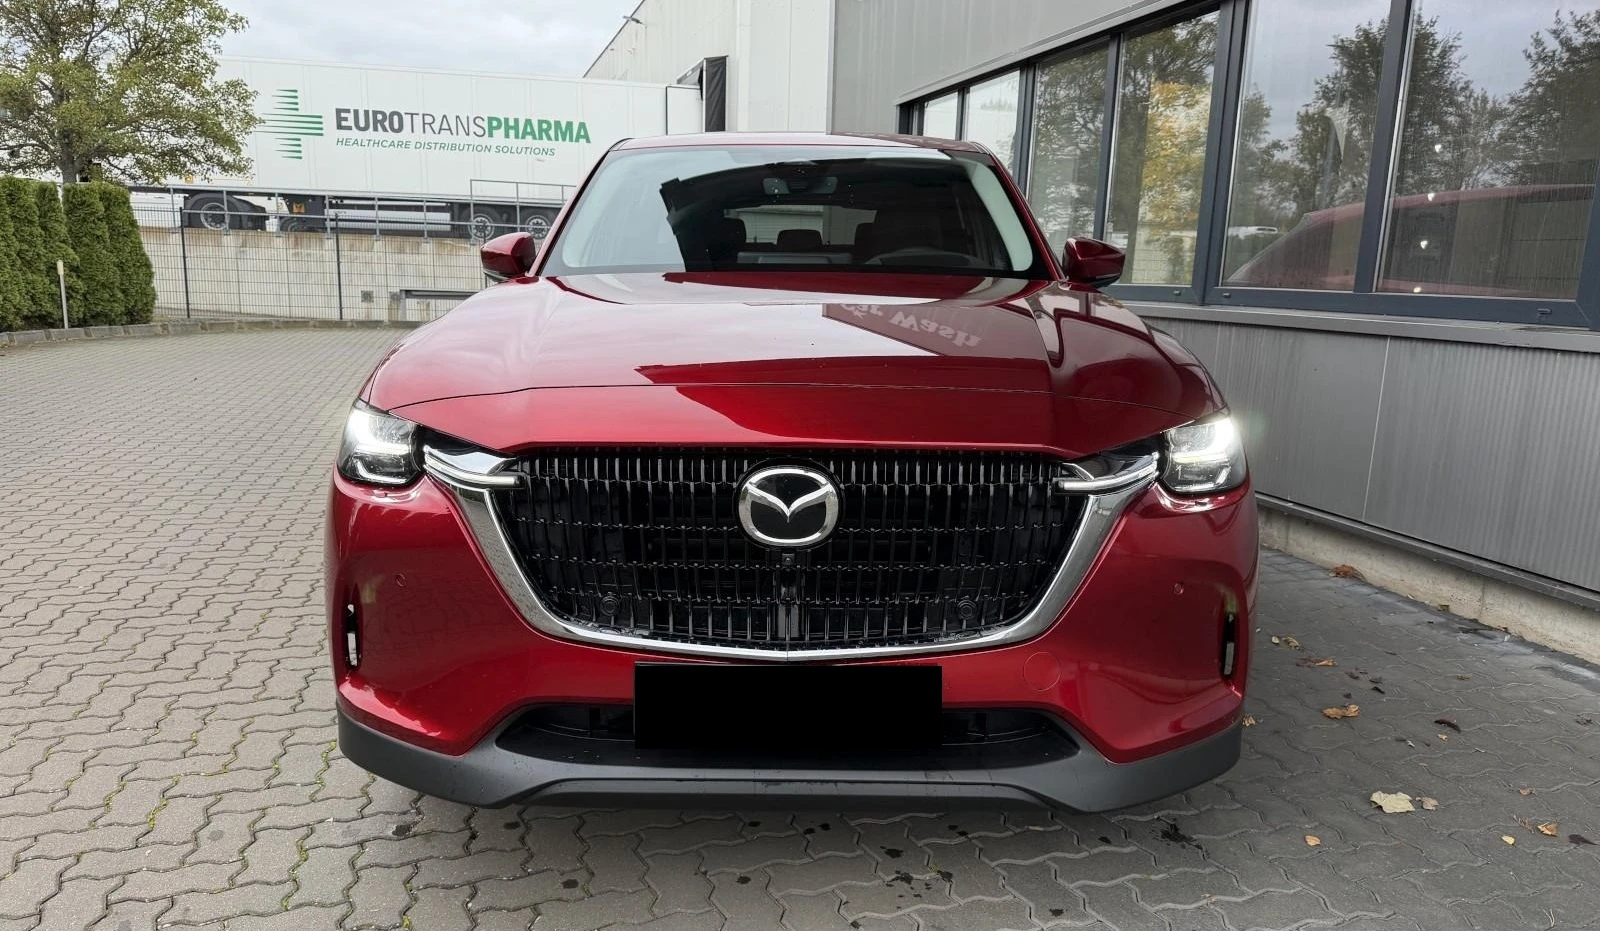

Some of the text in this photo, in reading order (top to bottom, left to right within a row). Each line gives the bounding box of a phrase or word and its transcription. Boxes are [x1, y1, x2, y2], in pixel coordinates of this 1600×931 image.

[335, 107, 592, 144] EUROTRANSPHARMA
[336, 137, 556, 156] HEALTHCARE DISTRIBUTION SOLUTIONS
